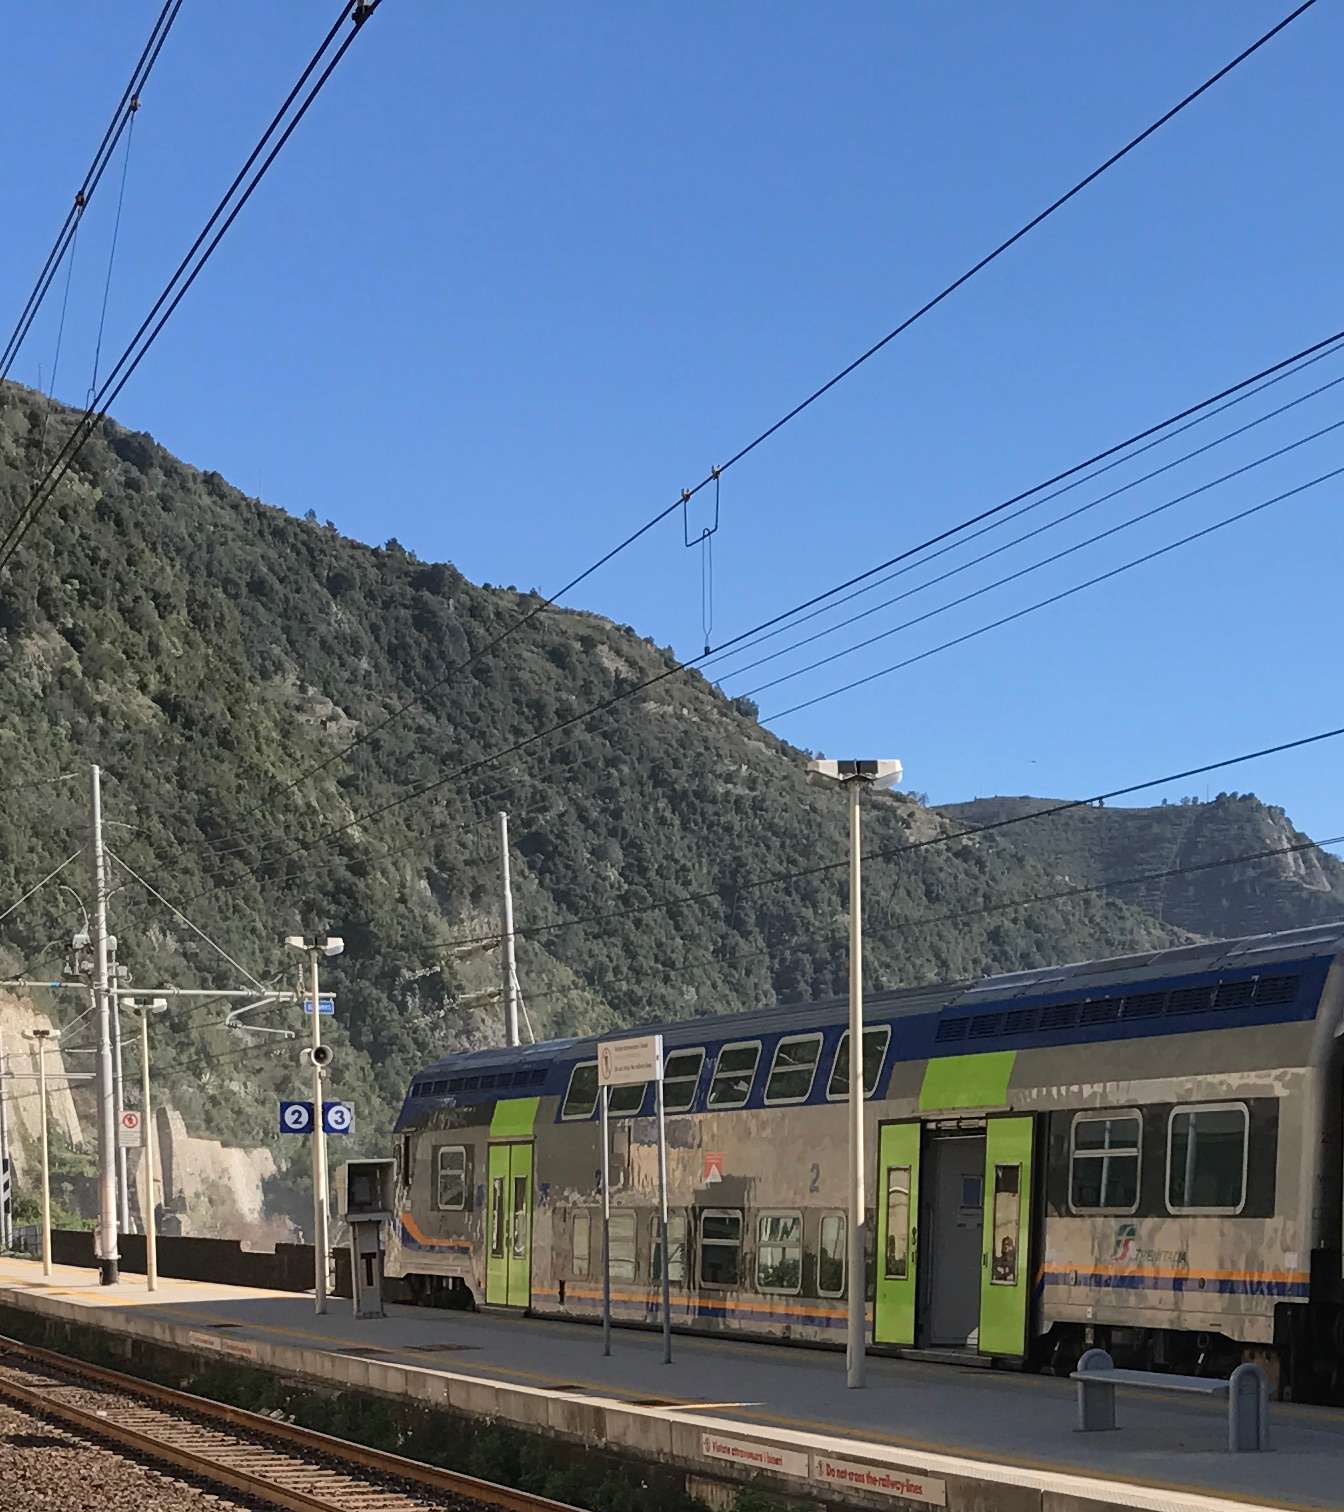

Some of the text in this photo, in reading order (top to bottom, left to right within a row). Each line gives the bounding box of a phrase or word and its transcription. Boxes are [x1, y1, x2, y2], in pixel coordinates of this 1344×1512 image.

[291, 1109, 303, 1125] 2
[334, 1110, 346, 1126] 3
[809, 1163, 821, 1194] 2
[826, 1463, 835, 1478] Do
[836, 1469, 847, 1479] not
